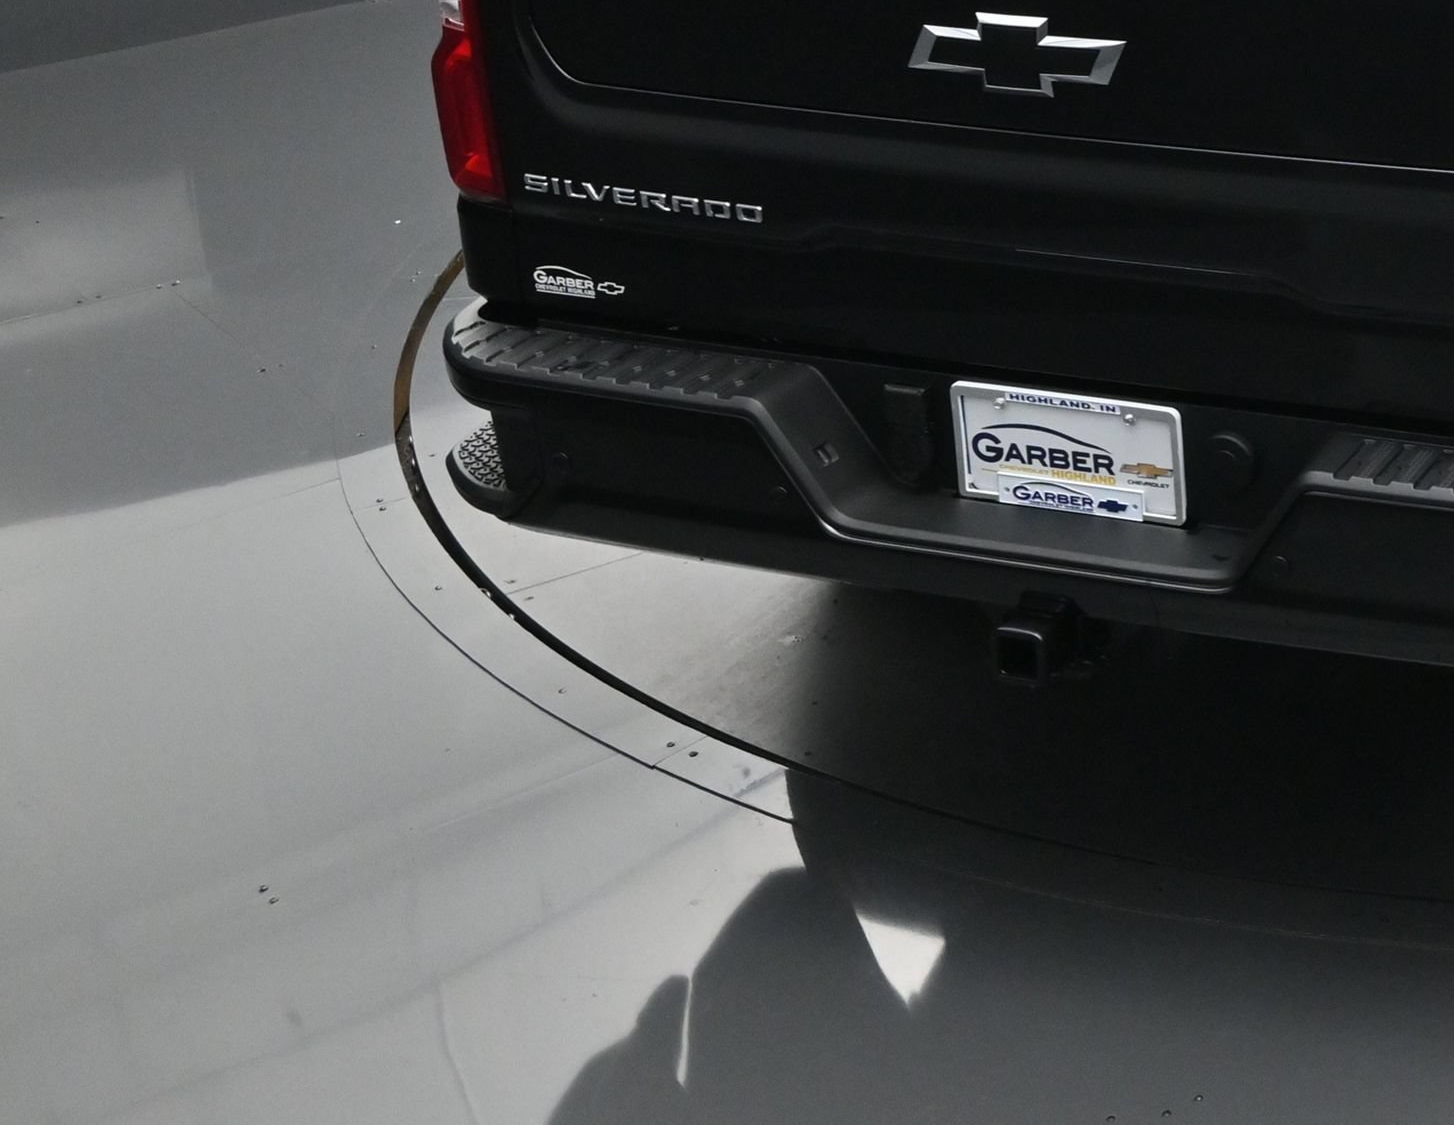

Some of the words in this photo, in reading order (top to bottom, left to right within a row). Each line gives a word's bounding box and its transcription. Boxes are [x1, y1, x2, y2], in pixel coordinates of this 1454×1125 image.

[523, 173, 763, 223] SILVERADO
[533, 269, 594, 290] GARBER
[1100, 404, 1117, 413] IN
[972, 432, 1116, 476] GARBER
[1050, 469, 1116, 486] HIGHLAND
[1012, 485, 1094, 508] GARBER
